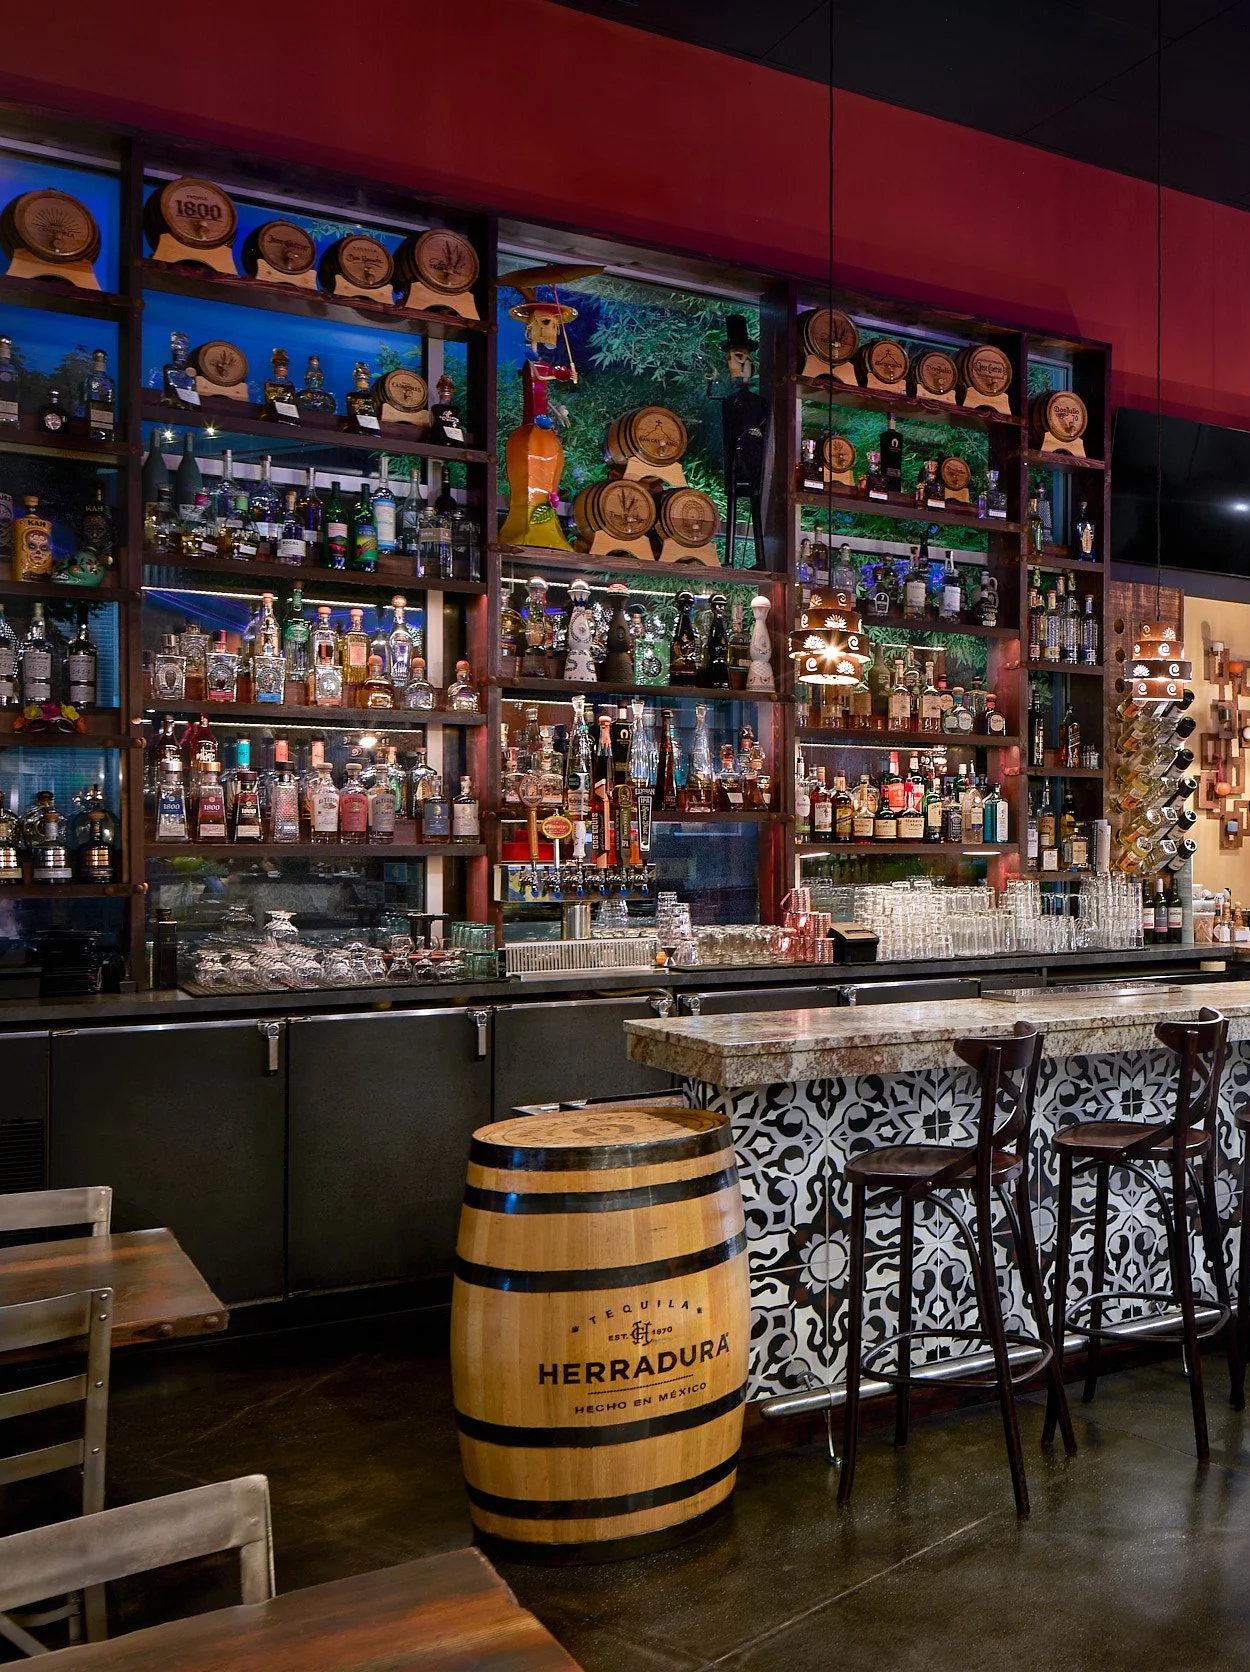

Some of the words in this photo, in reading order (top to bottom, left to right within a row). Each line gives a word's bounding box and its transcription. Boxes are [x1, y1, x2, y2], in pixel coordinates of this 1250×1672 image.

[175, 200, 222, 219] 1800
[27, 519, 46, 528] KAH
[588, 1299, 689, 1325] TEQUILA
[608, 1333, 629, 1342] EST.
[652, 1326, 673, 1335] 1870
[538, 1335, 730, 1386] HERRADURA
[575, 1401, 627, 1414] HECHO
[633, 1397, 652, 1407] EN
[658, 1382, 707, 1402] MÉXICO
